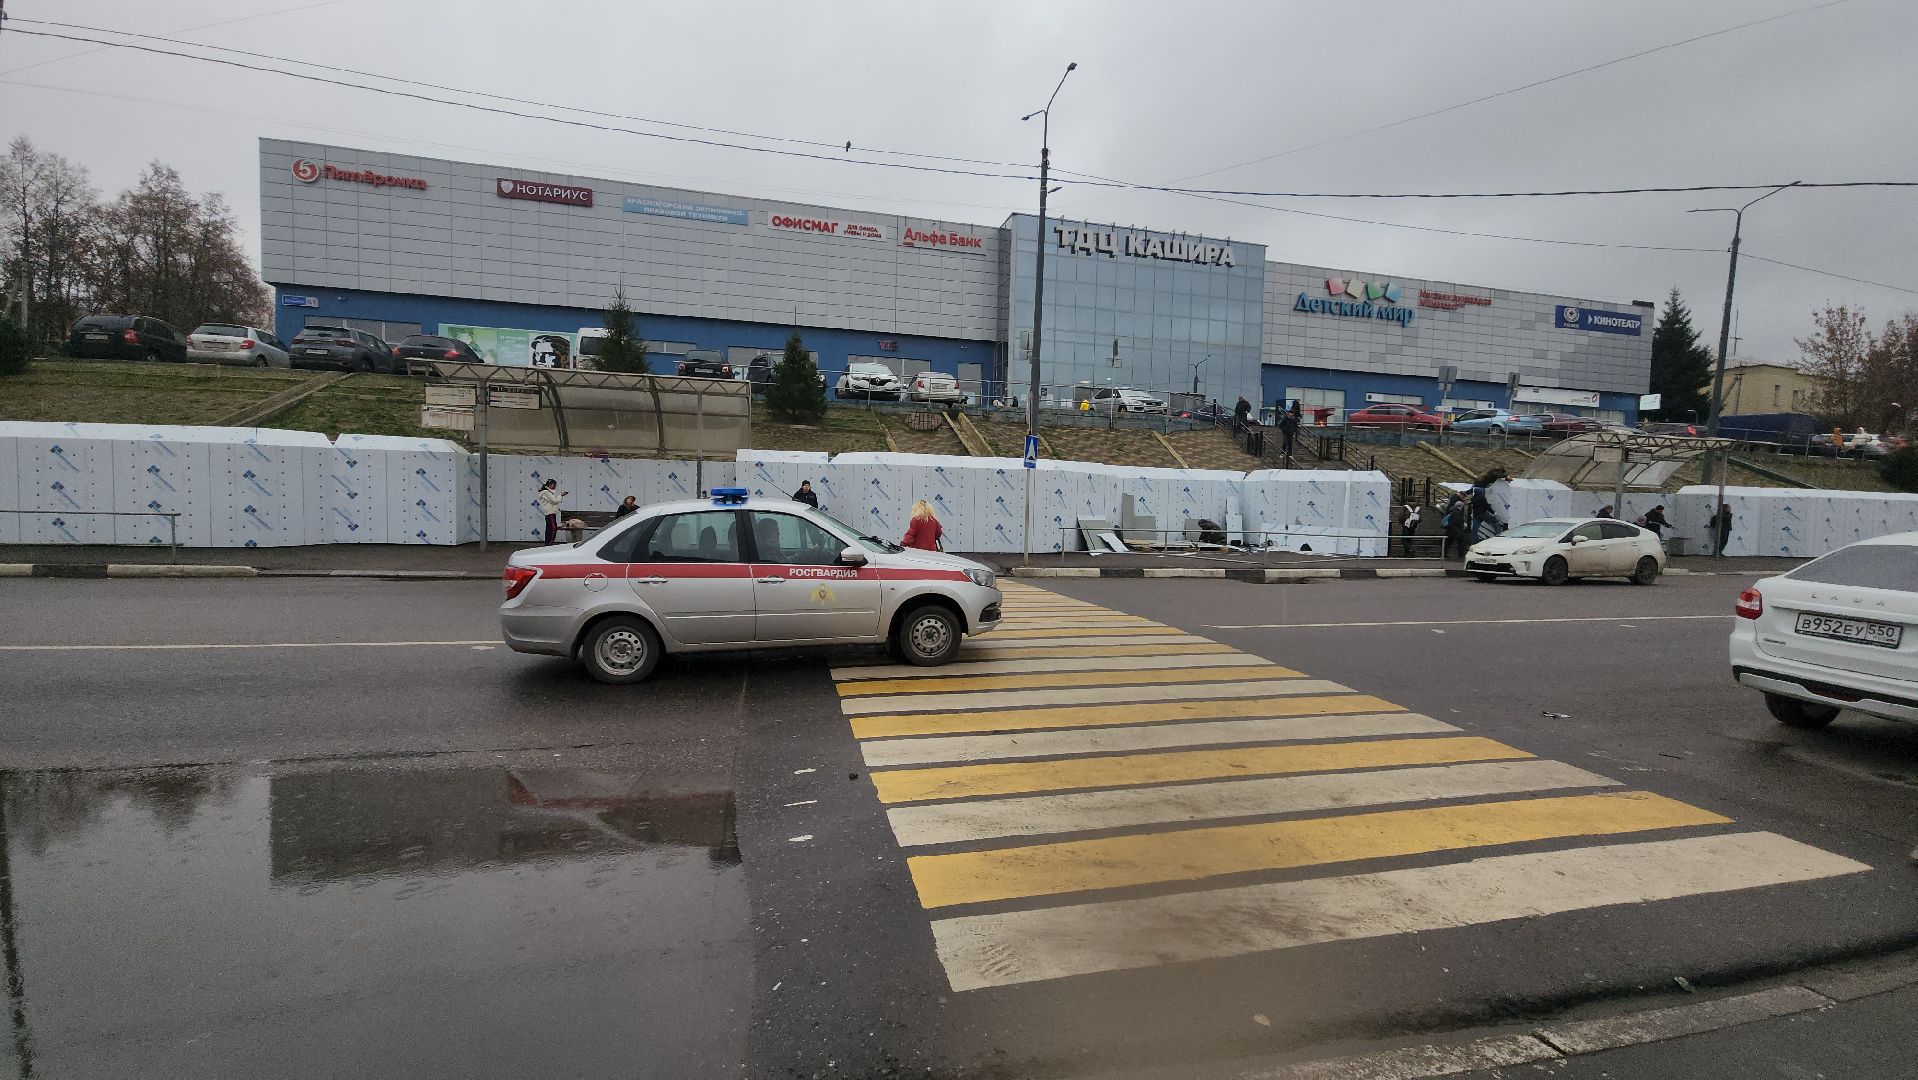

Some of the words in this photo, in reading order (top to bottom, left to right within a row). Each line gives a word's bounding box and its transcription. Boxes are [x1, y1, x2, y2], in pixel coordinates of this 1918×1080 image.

[516, 184, 588, 201] НОТАРИУС
[771, 215, 838, 233] ОФИСМАГ
[903, 227, 947, 247] Альфа
[949, 233, 982, 248] Банк
[1054, 225, 1118, 257] ТДЦ
[1125, 233, 1236, 268] КАШИРА
[1294, 292, 1375, 318] Детский
[1376, 305, 1415, 327] мир
[1594, 315, 1640, 328] КИНОТЕАТР
[789, 568, 858, 579] РОСГВАРДИЯ
[1867, 624, 1895, 638] 550
